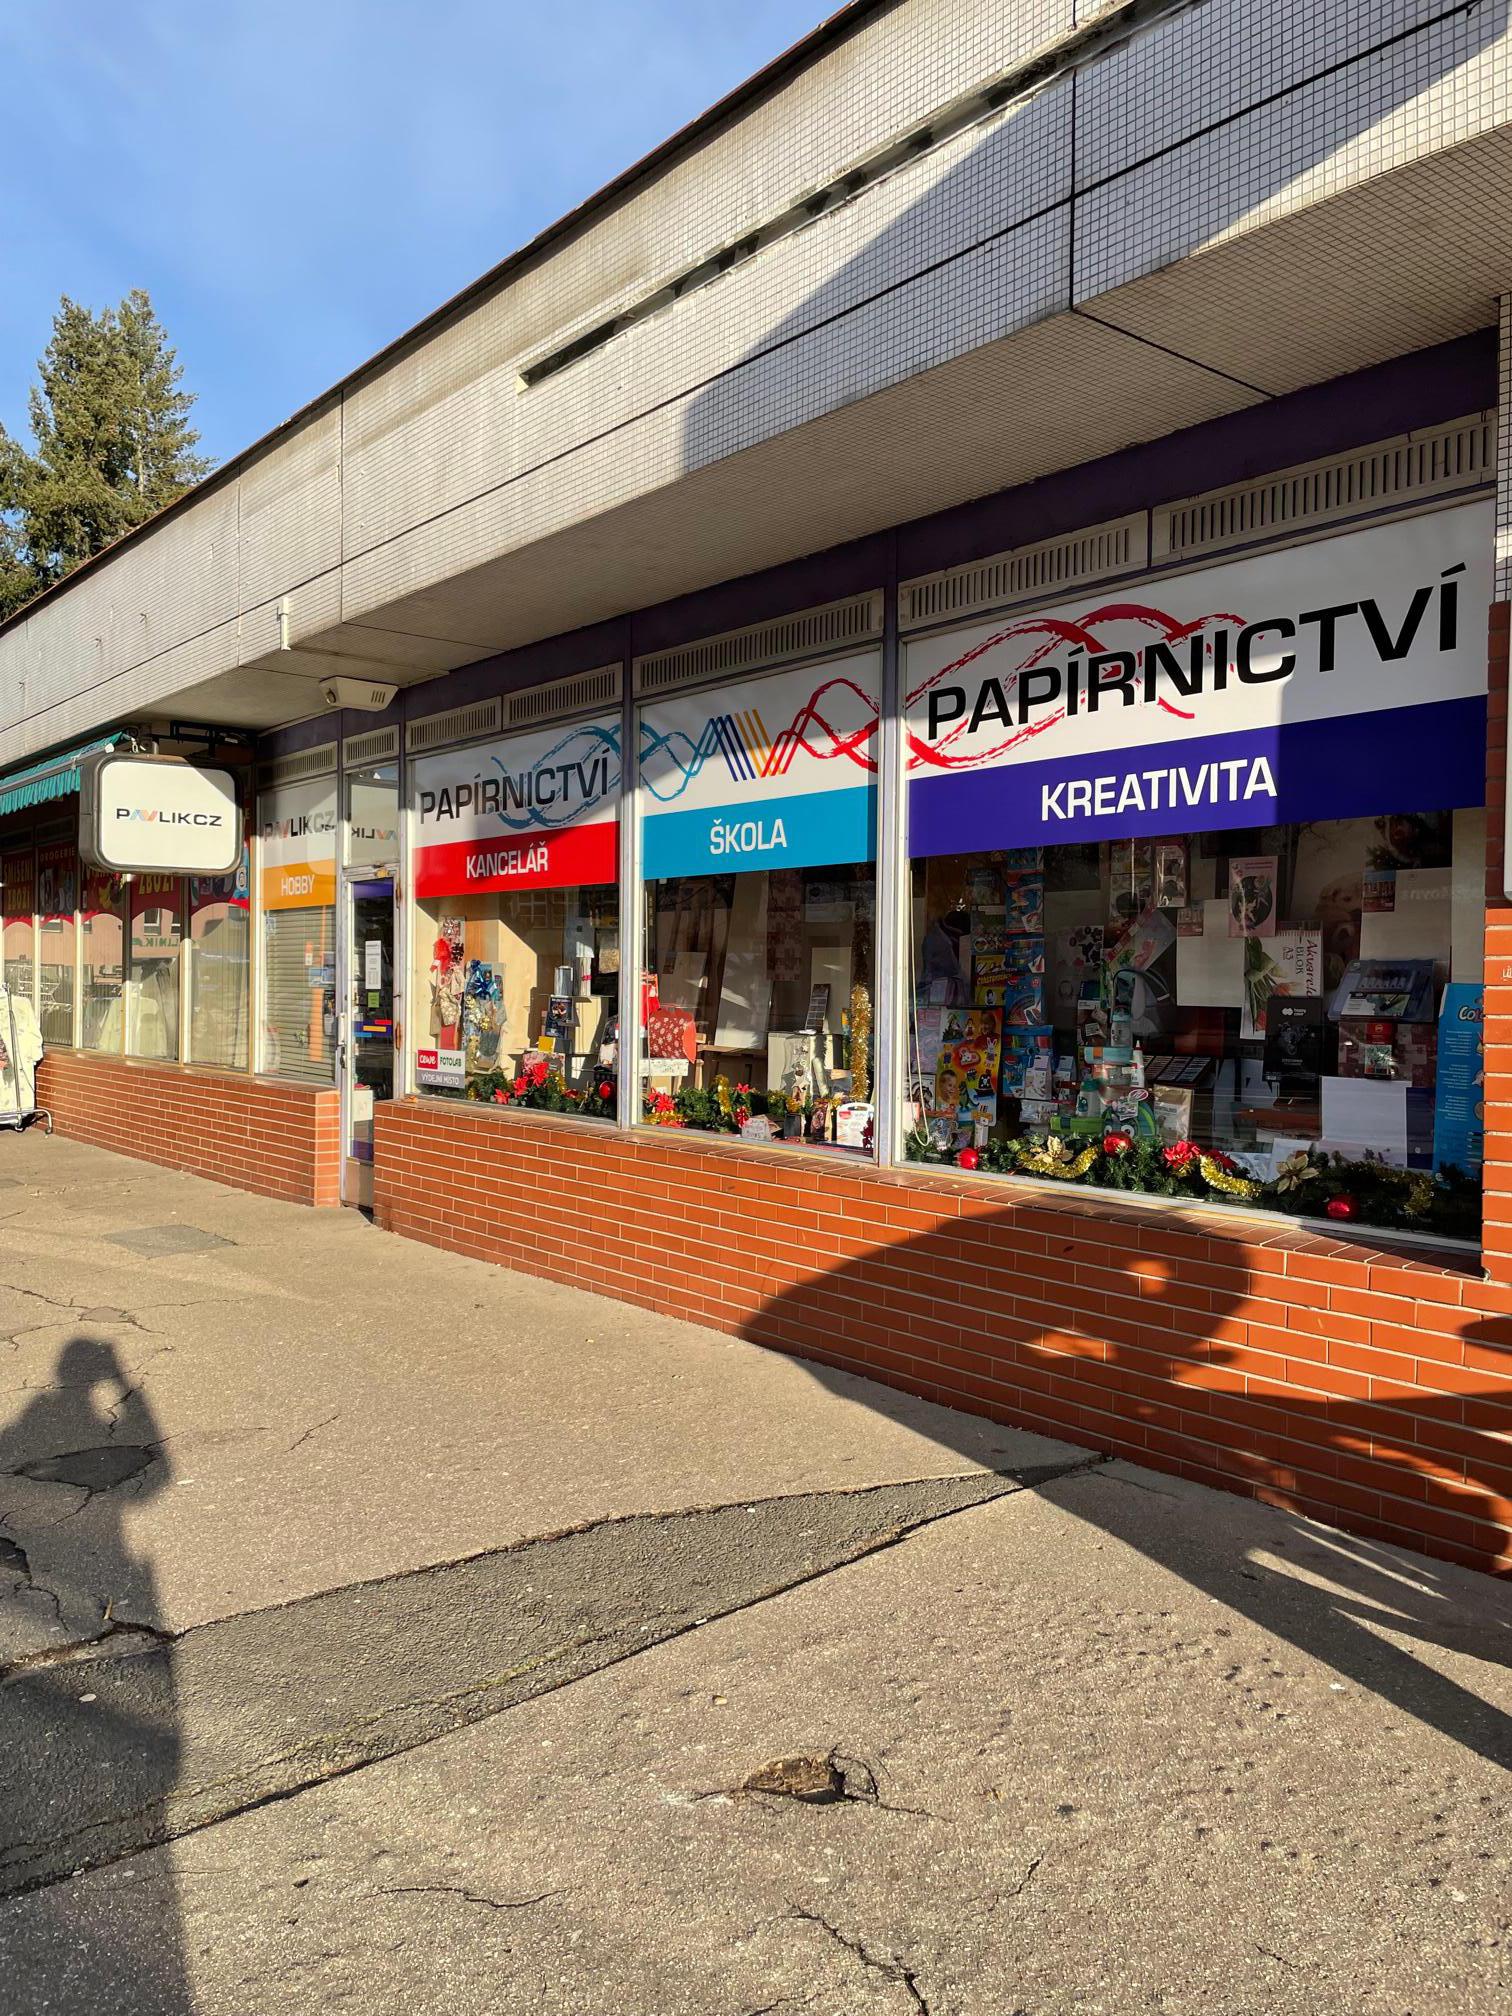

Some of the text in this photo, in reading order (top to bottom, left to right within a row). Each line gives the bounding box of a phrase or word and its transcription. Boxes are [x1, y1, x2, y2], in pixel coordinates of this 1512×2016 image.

[928, 562, 1466, 740] PAPÍRNICTVÍ
[420, 748, 608, 825] PAPÍRNICTVÍ
[1041, 756, 1278, 822] KREATIVITA
[709, 818, 788, 855] ŠKOLA
[466, 841, 549, 879] KANCELÁŘ
[281, 875, 315, 897] HOBBY
[1295, 946, 1304, 975] BLOK
